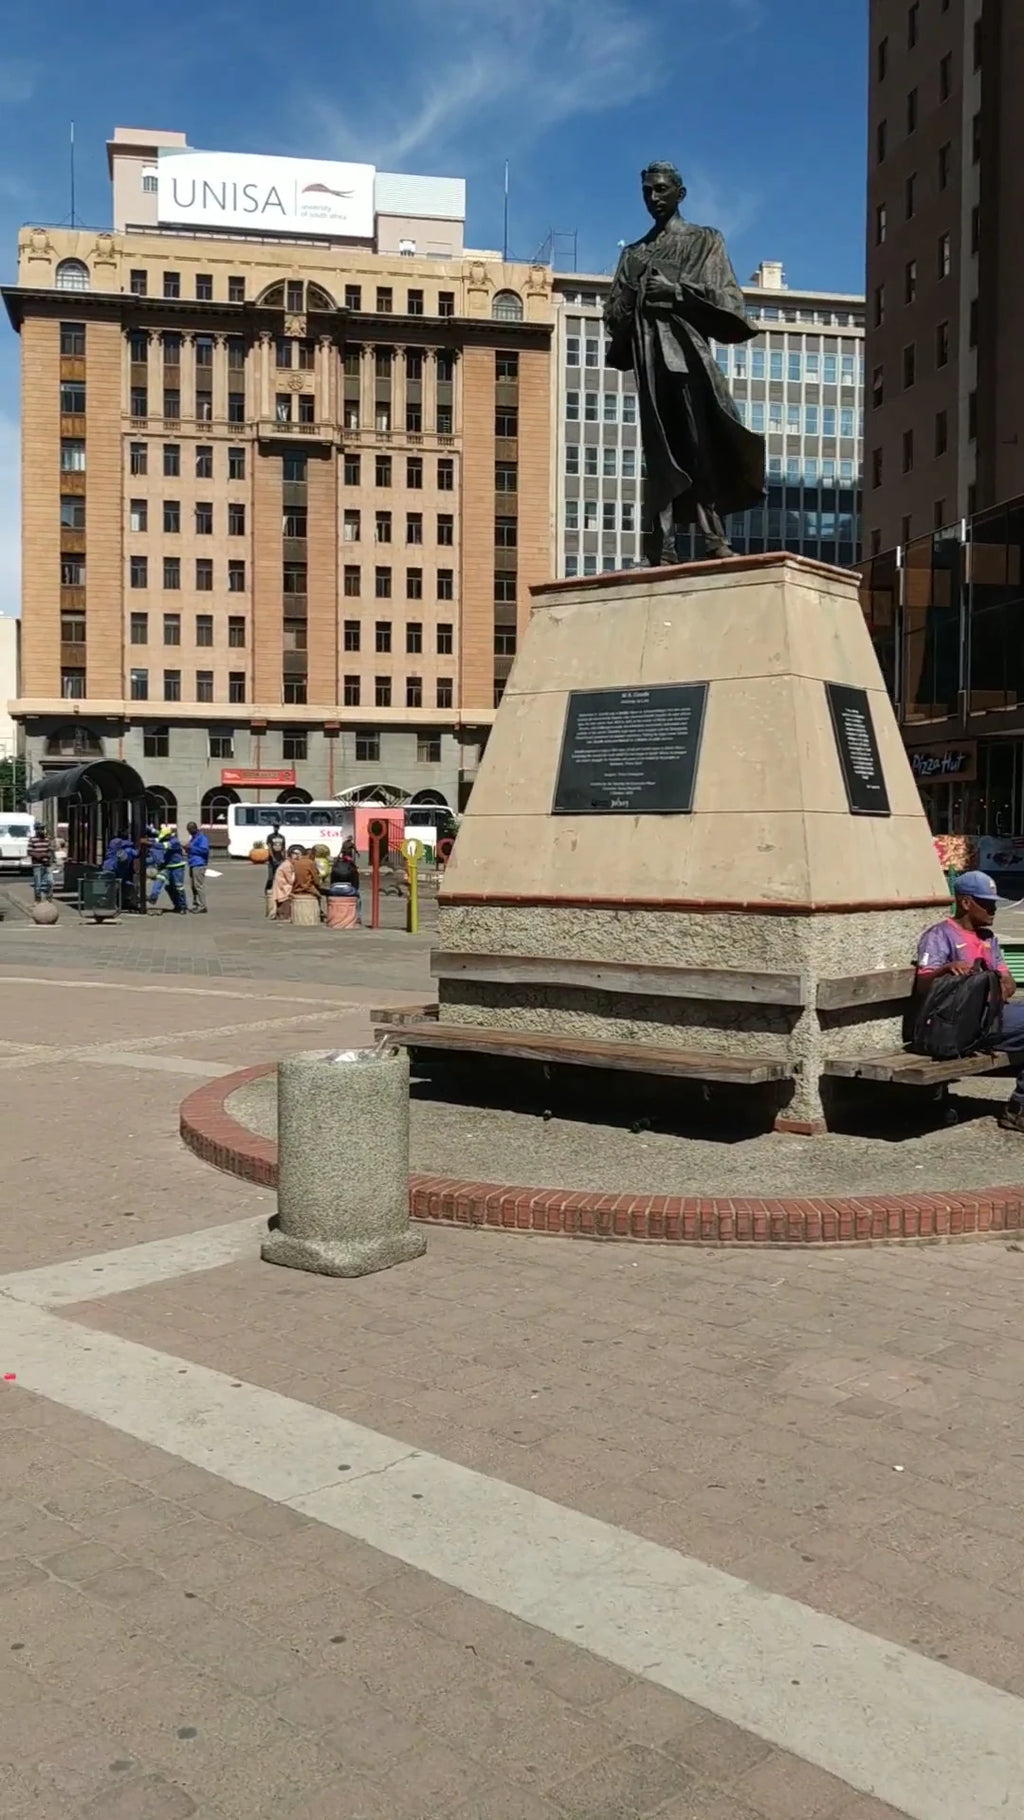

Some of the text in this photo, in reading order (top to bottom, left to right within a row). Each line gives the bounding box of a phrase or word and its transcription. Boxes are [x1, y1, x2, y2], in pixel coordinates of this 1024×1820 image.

[172, 178, 286, 215] UNISA
[912, 752, 965, 775] Pizza Hut
